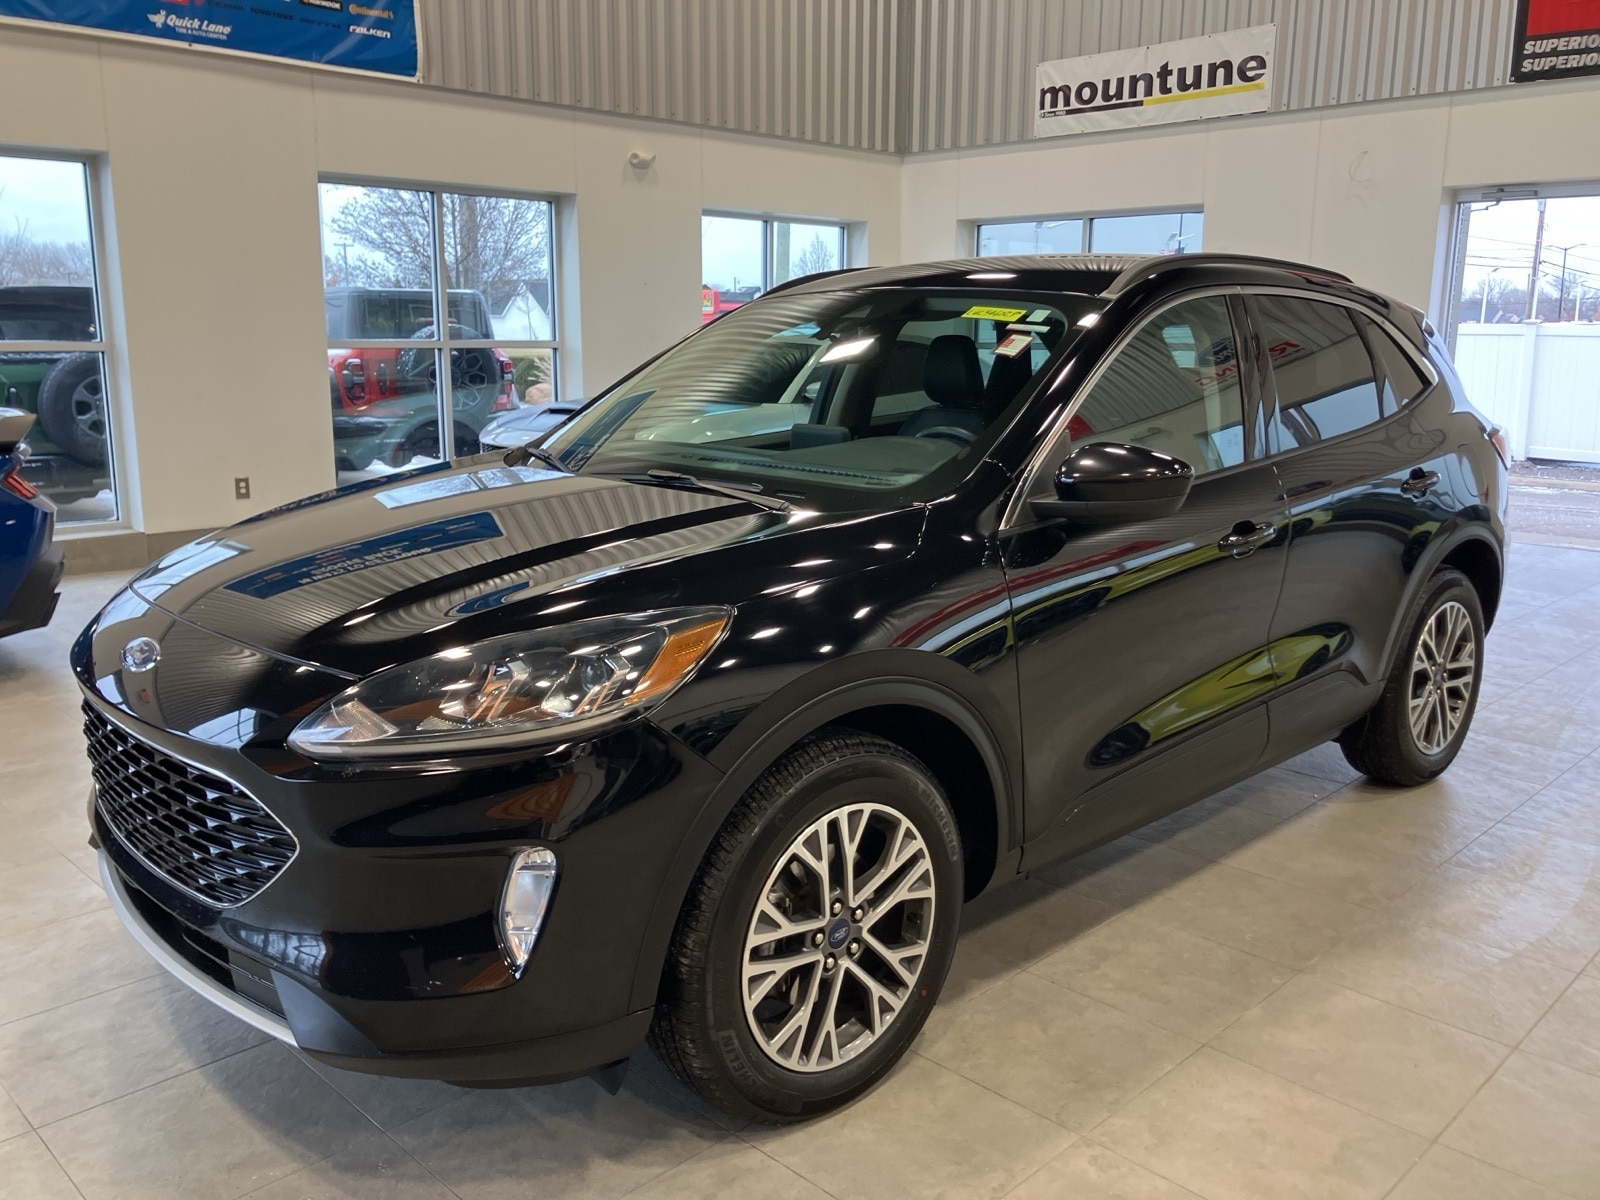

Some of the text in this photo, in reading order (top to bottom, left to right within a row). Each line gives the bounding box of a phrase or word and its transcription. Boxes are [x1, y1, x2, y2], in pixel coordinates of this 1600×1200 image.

[166, 14, 232, 35] Quick Lane
[349, 25, 391, 39] FALKEN
[1523, 34, 1600, 54] SUPERIO
[1521, 52, 1600, 72] SUPERIO
[1039, 54, 1267, 111] mountune
